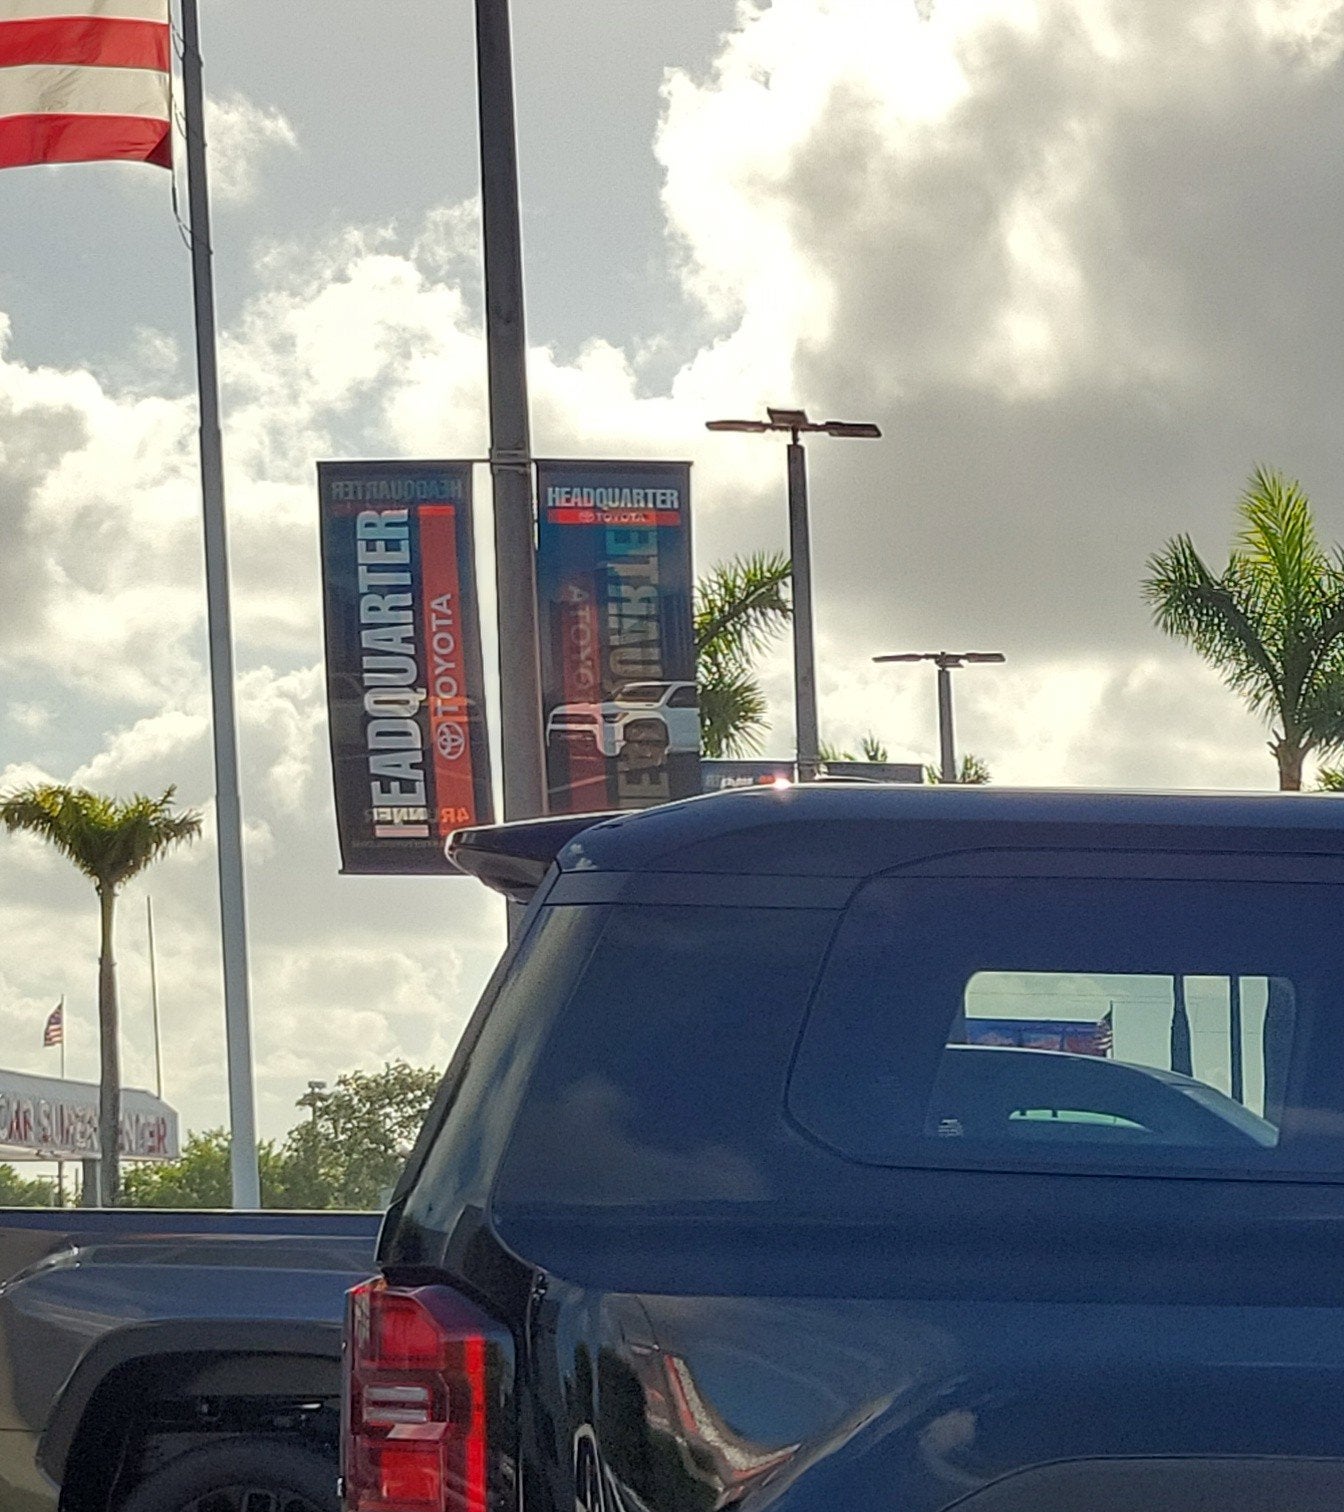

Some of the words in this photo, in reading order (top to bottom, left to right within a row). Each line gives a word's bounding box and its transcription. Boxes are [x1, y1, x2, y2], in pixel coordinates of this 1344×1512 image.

[547, 486, 680, 509] HEADQUARTER
[595, 511, 647, 523] TOYOTA
[356, 508, 430, 838] HEADQUARTER
[429, 594, 460, 717] TOYOTA
